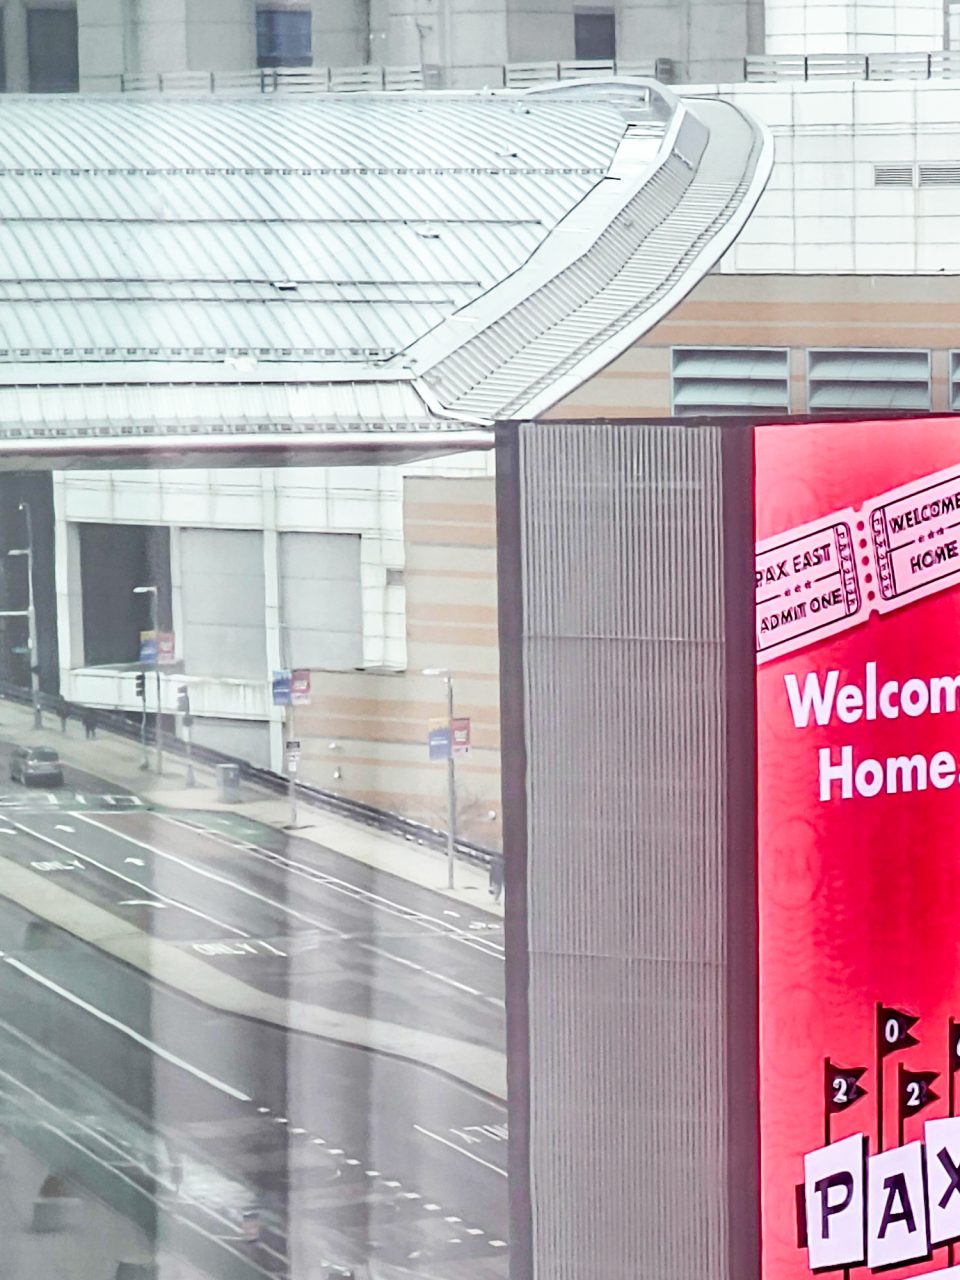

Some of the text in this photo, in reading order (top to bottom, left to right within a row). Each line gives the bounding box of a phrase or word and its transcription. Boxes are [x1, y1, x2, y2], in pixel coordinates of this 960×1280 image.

[792, 543, 831, 573] EAST
[910, 540, 959, 574] HOME
[761, 588, 843, 633] ADMIT ONE
